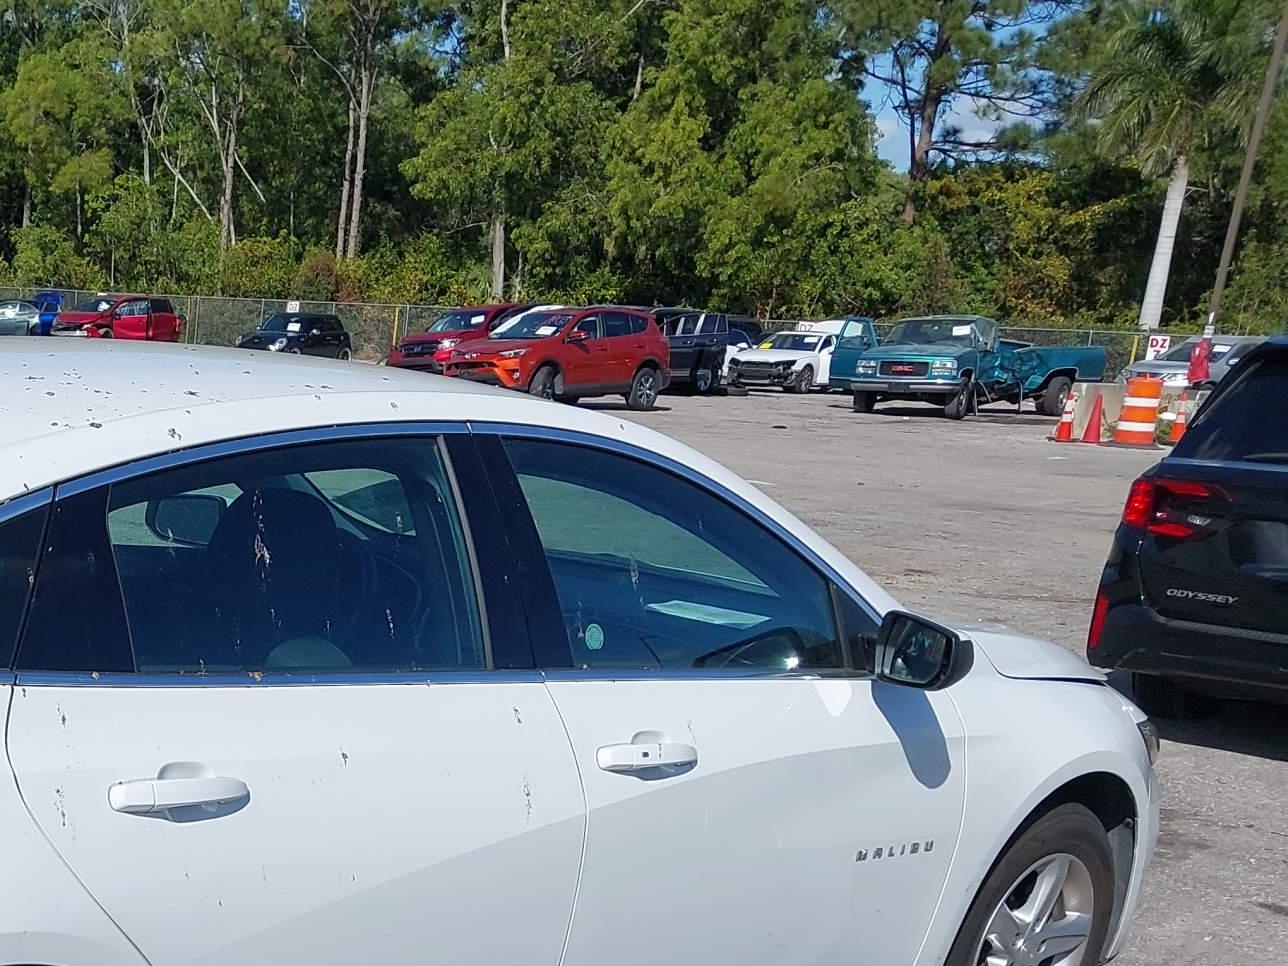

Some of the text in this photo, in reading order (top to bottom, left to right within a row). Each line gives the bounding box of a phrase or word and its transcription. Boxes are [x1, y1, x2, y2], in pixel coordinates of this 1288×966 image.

[1150, 337, 1168, 349] DZ
[1166, 588, 1239, 604] ODYSSEY
[855, 840, 934, 862] MALIBU
